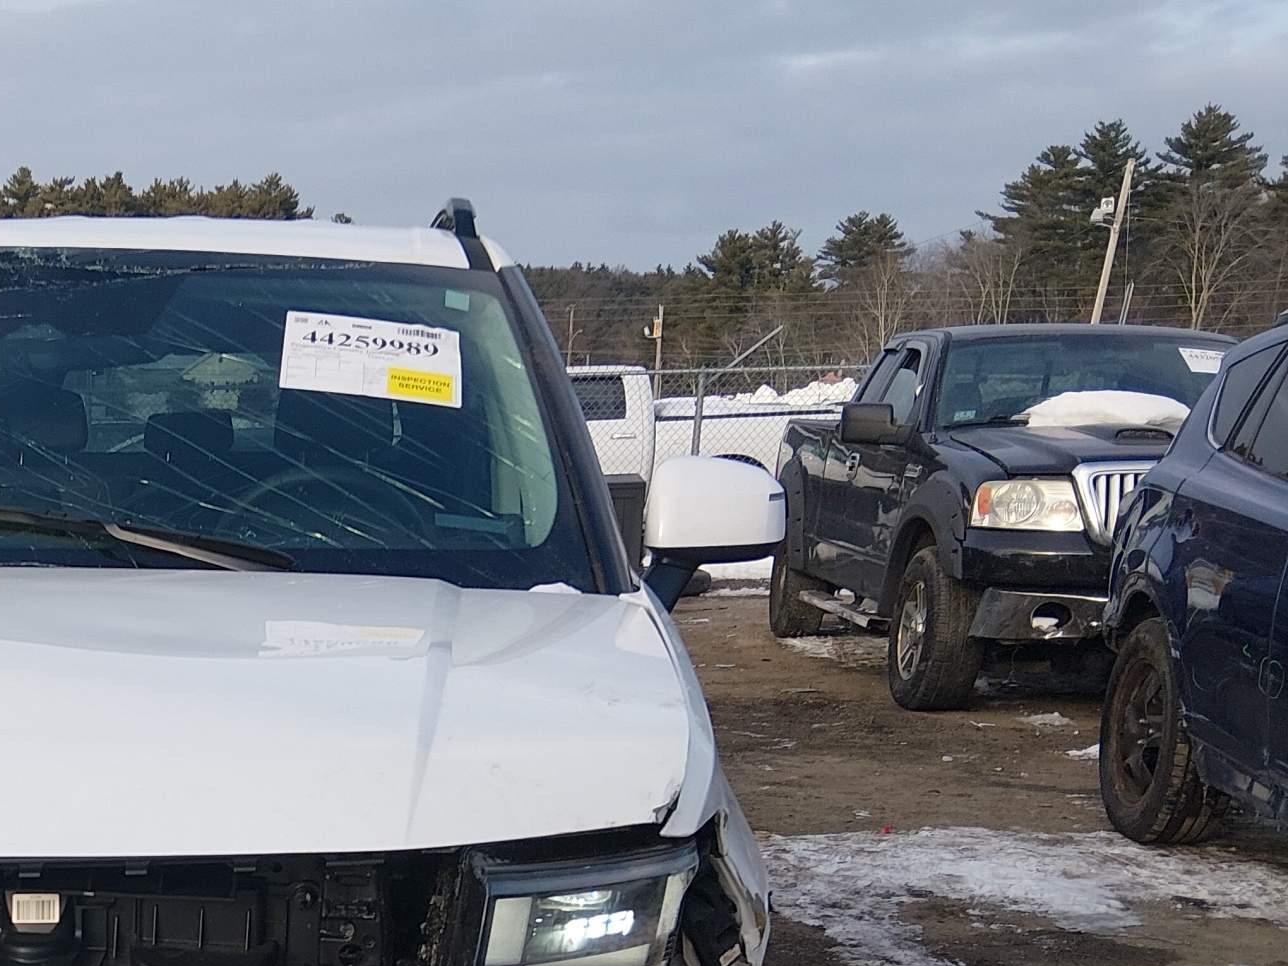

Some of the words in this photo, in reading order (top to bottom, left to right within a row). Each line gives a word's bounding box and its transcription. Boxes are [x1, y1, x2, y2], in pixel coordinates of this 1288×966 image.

[302, 330, 440, 357] 44259989
[391, 374, 451, 388] INSPECTION
[398, 382, 442, 393] SERVICE
